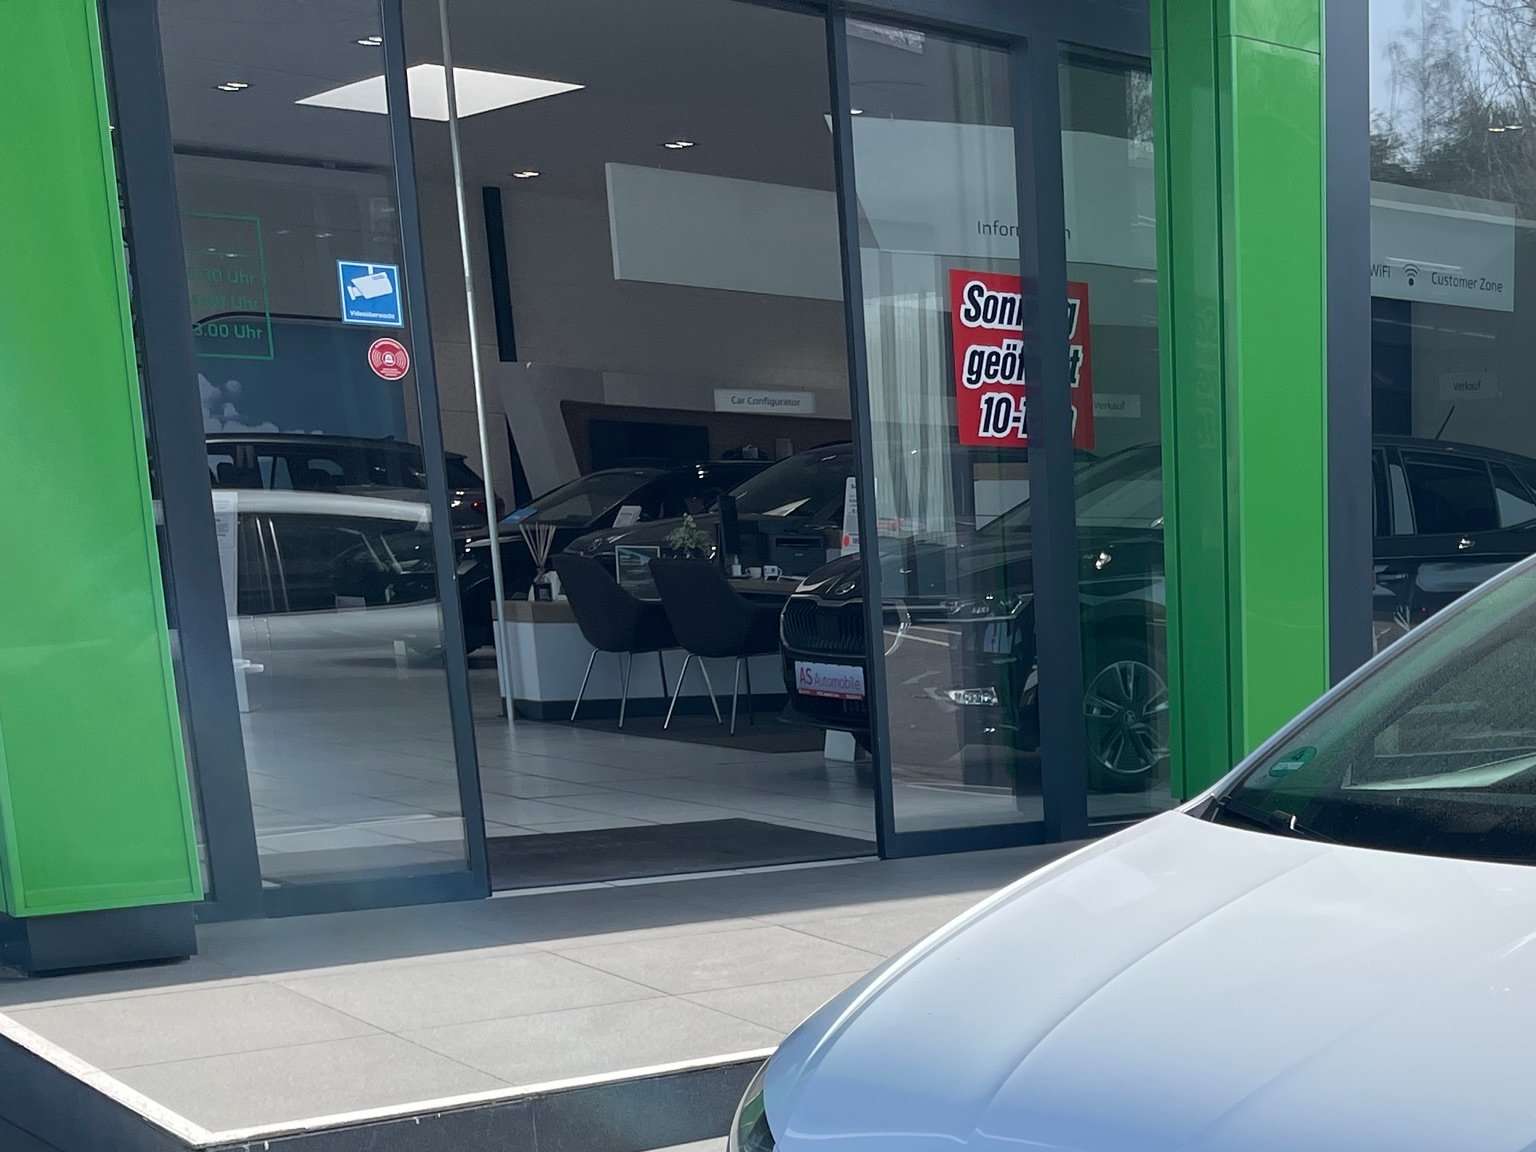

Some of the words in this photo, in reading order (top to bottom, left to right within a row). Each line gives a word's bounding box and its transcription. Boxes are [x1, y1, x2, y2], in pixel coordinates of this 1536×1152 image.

[1431, 271, 1478, 290] Customer
[1480, 277, 1503, 293] Zone
[235, 324, 262, 338] Uhr
[730, 395, 745, 405] Car
[747, 396, 800, 408] Configurator
[800, 667, 813, 686] AS
[815, 673, 862, 690] Automobile
